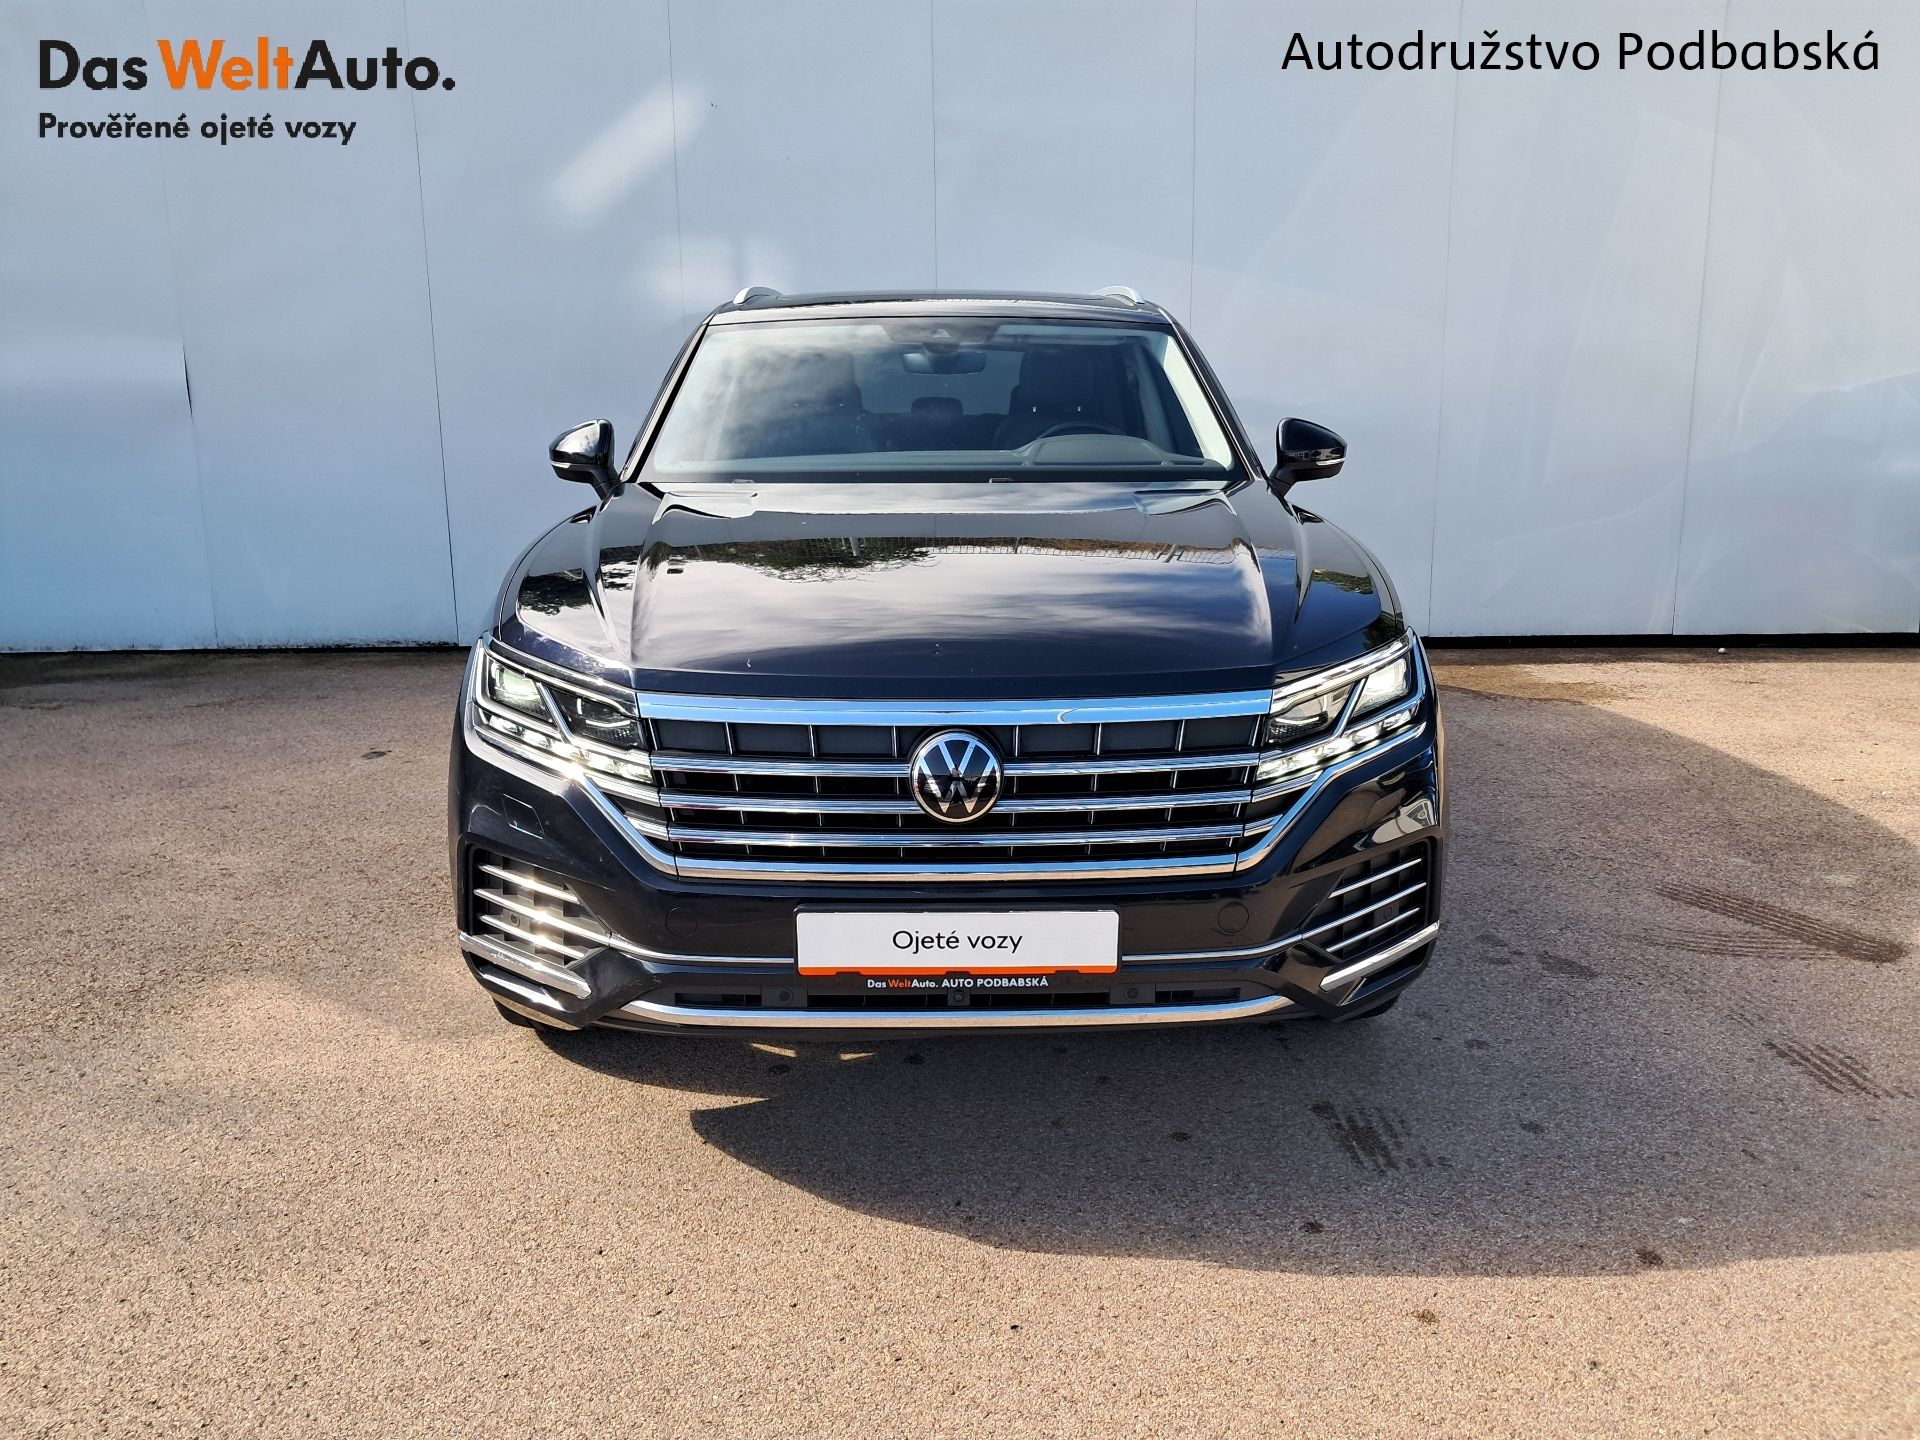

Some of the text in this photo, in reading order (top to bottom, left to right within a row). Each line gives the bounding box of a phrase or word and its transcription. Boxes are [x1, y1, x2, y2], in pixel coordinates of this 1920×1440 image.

[912, 731, 1001, 822] VW
[892, 930, 1023, 955] Ojeté vozy
[867, 975, 1049, 988] Das WeltAuto. AUTO PODBABSKÁ
